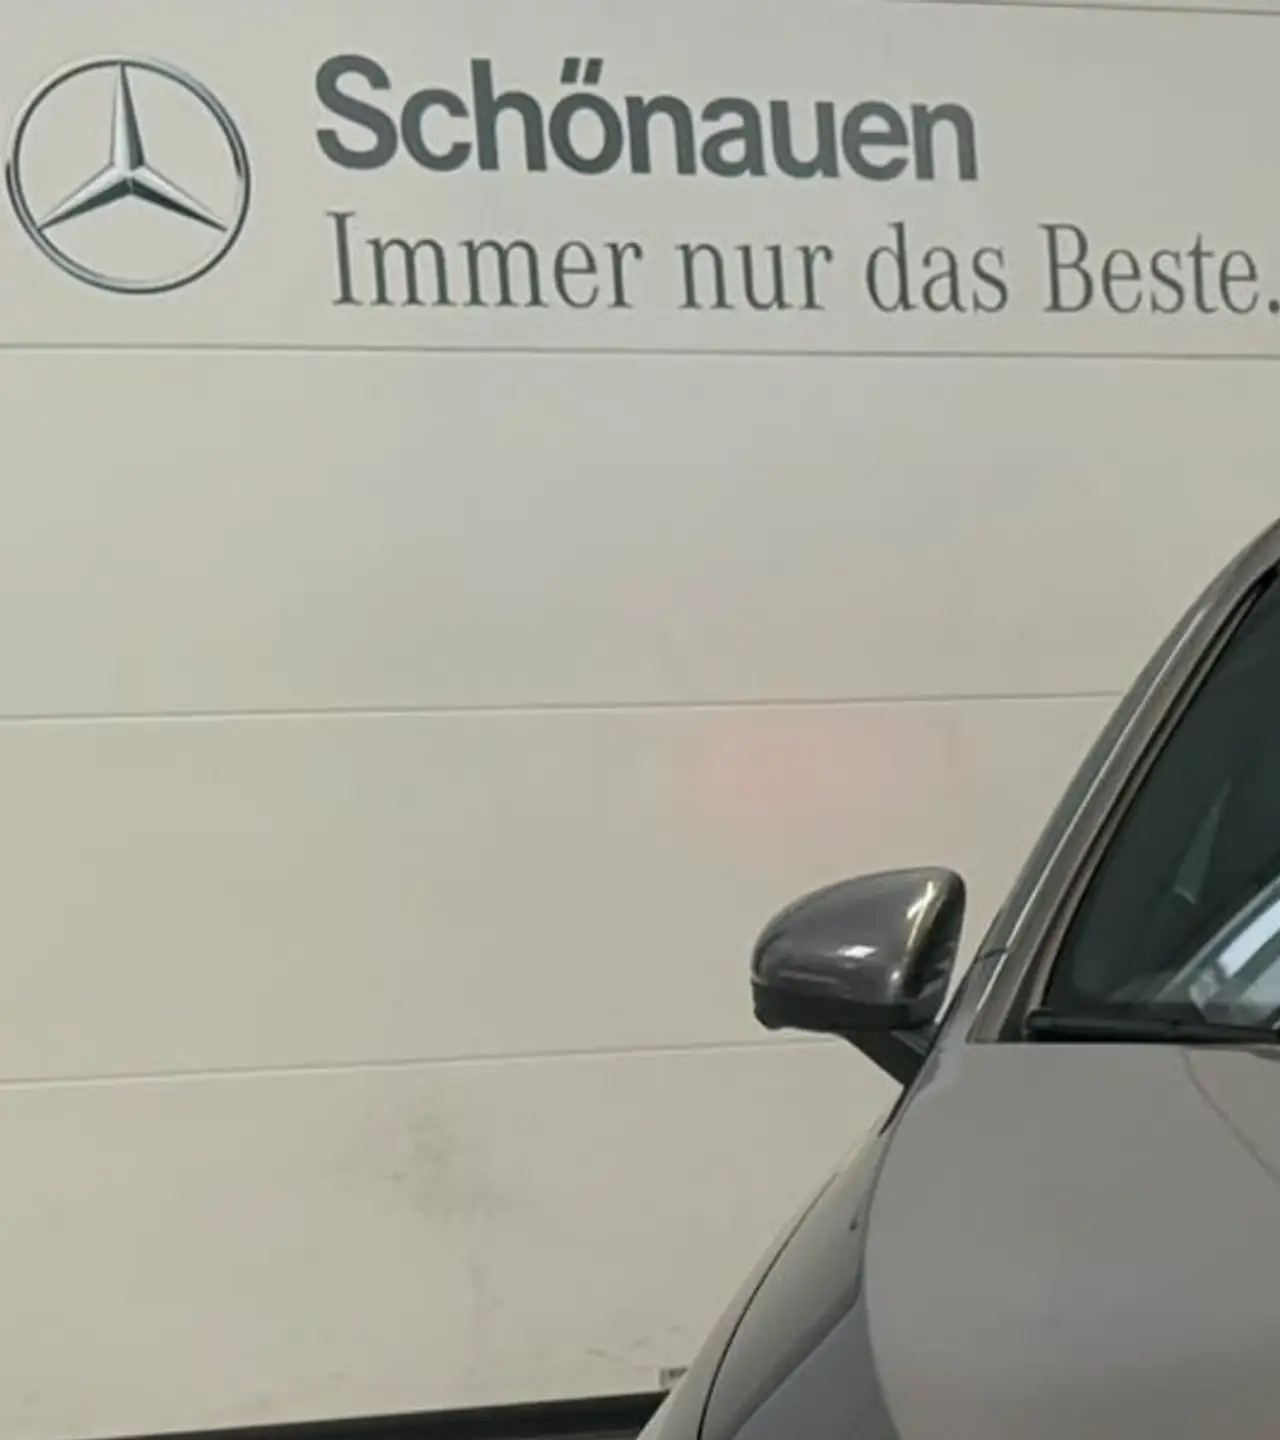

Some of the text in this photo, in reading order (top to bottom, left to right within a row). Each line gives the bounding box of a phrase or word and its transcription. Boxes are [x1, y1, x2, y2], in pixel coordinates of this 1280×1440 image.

[315, 54, 978, 181] Schönauen
[327, 211, 642, 309] Immer
[675, 240, 833, 311] nur
[866, 220, 1009, 314] das
